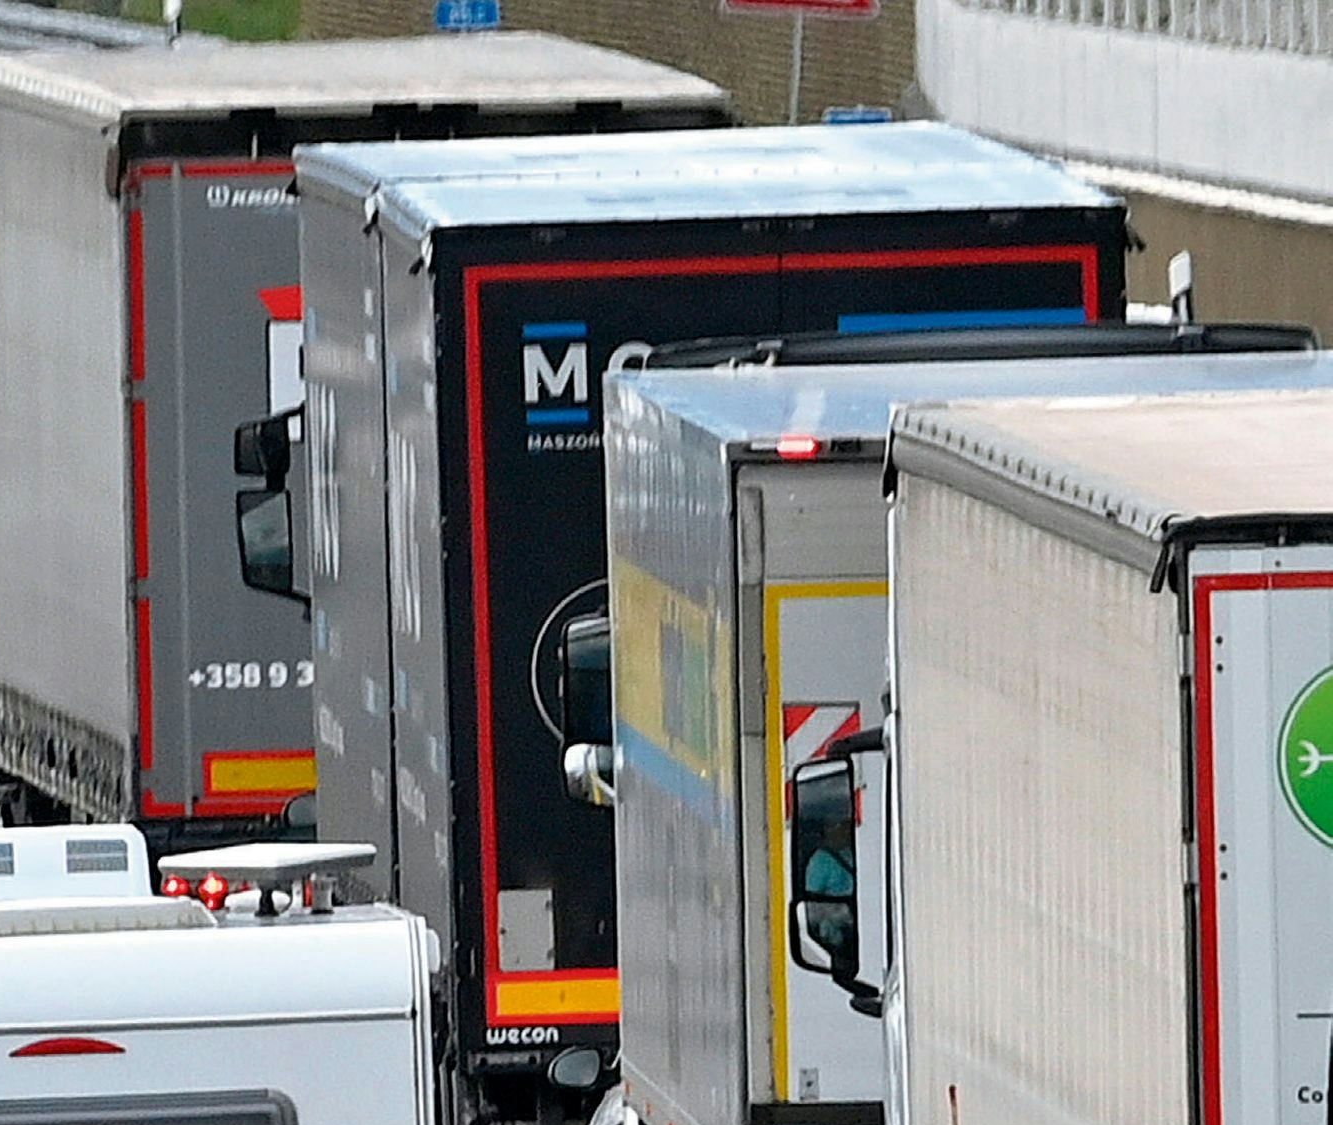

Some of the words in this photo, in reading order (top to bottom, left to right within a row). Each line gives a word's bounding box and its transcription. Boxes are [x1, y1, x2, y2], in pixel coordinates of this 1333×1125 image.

[268, 661, 288, 688] 9
[296, 660, 315, 688] 3
[486, 1026, 560, 1046] wecon
